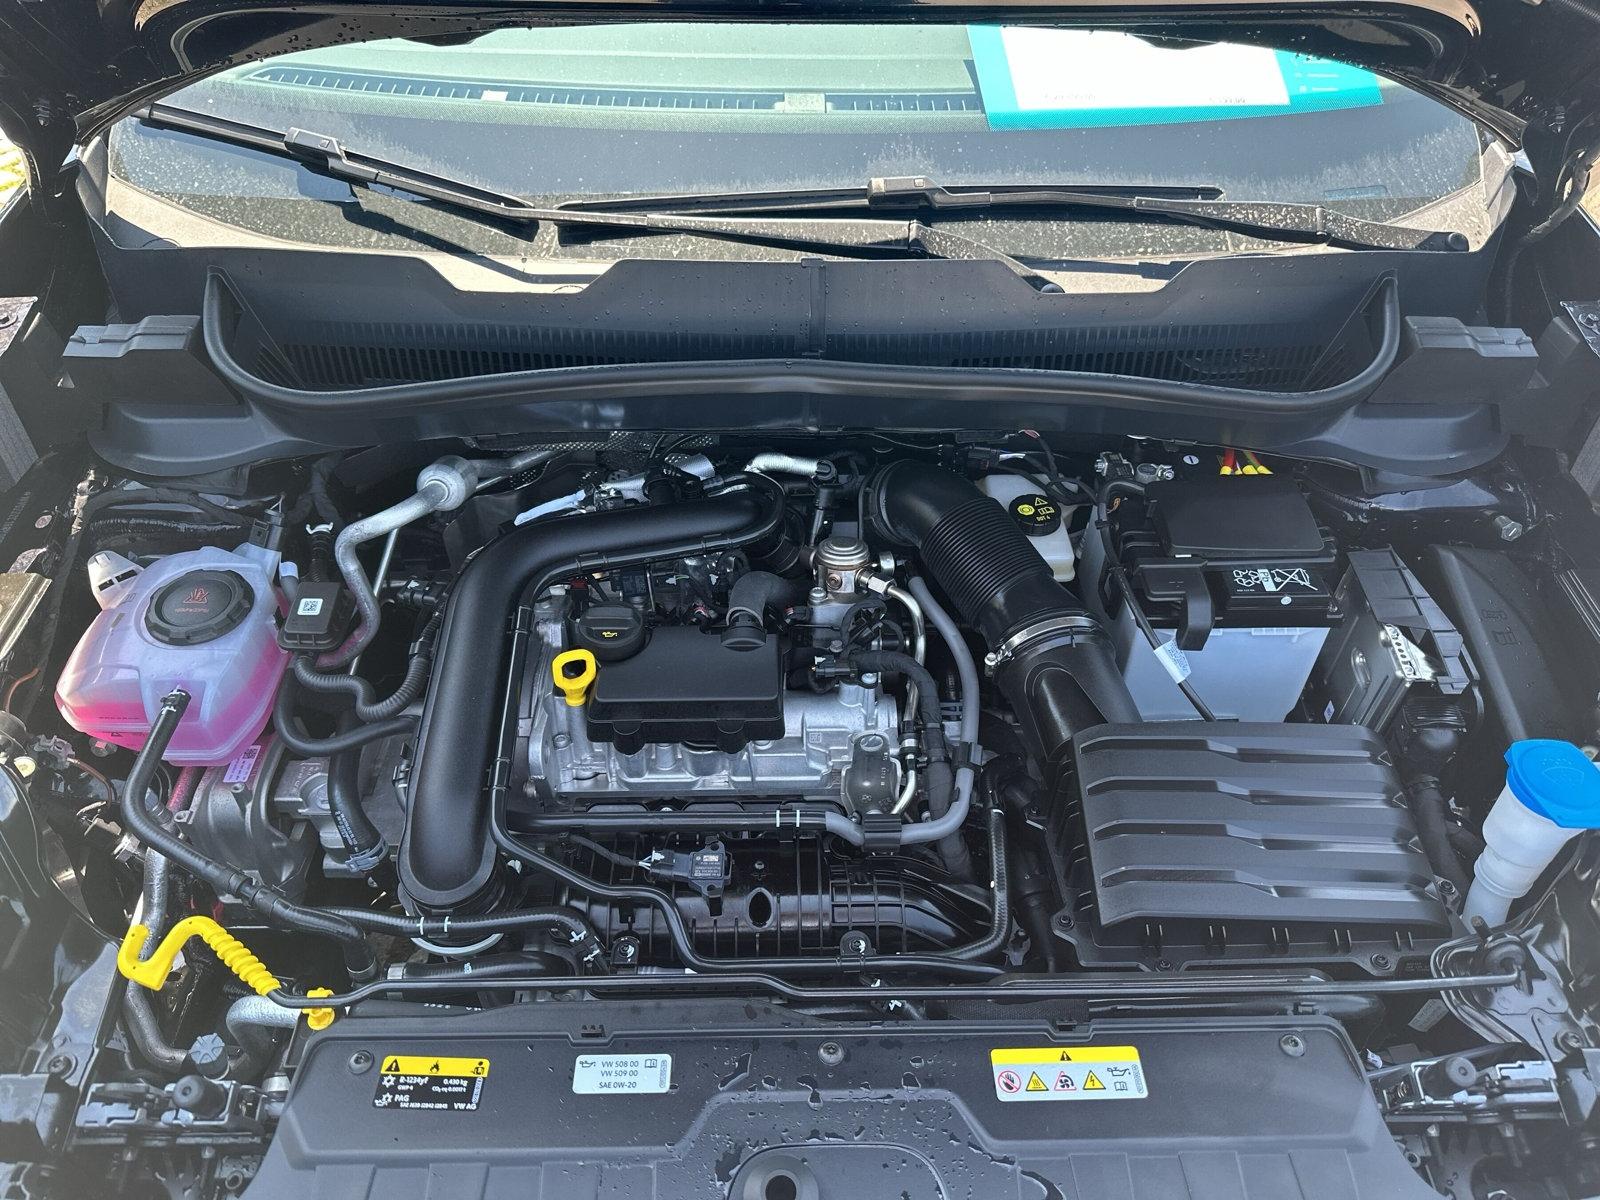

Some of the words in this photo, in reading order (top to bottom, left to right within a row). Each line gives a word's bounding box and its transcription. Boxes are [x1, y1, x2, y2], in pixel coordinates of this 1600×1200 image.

[400, 1076, 429, 1085] R-1234yf
[459, 1078, 468, 1087] kg
[394, 1094, 410, 1102] PAG
[453, 1102, 466, 1110] VW
